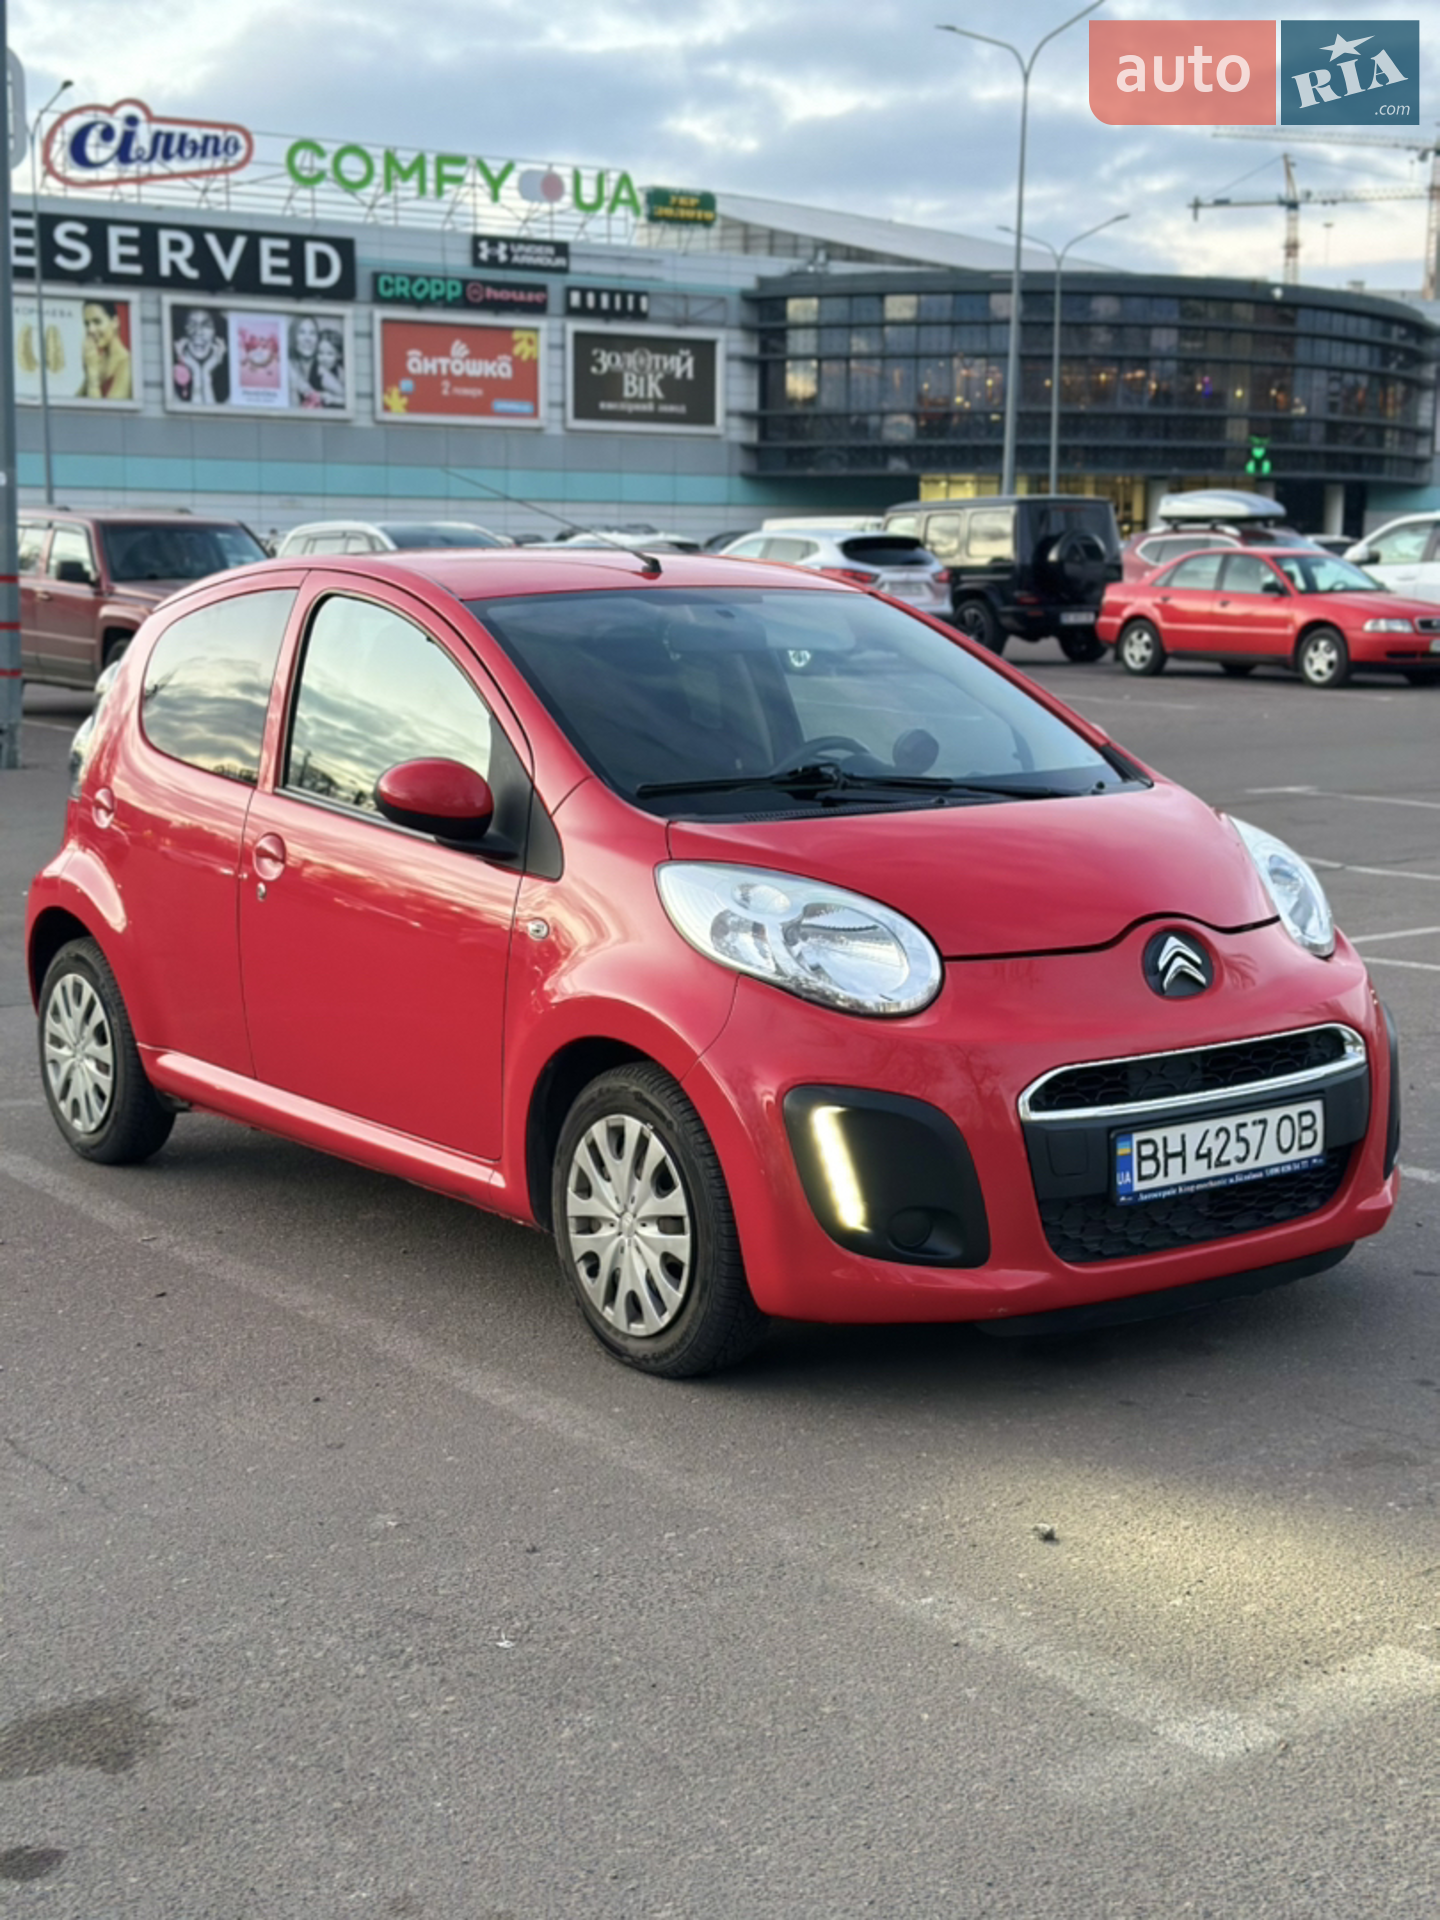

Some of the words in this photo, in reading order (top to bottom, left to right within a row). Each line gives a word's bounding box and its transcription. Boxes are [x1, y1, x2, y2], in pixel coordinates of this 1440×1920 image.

[69, 114, 242, 169] Сільпо
[286, 139, 516, 203] COMFY
[572, 168, 642, 218] UA
[11, 216, 342, 289] ESERVED
[510, 242, 556, 256] UNDER
[510, 253, 567, 268] ARMOUR
[378, 274, 463, 302] CROPP
[1136, 1132, 1187, 1182] BH
[1195, 1117, 1268, 1170] 4257
[1276, 1109, 1318, 1155] OB
[1116, 1170, 1132, 1186] UA
